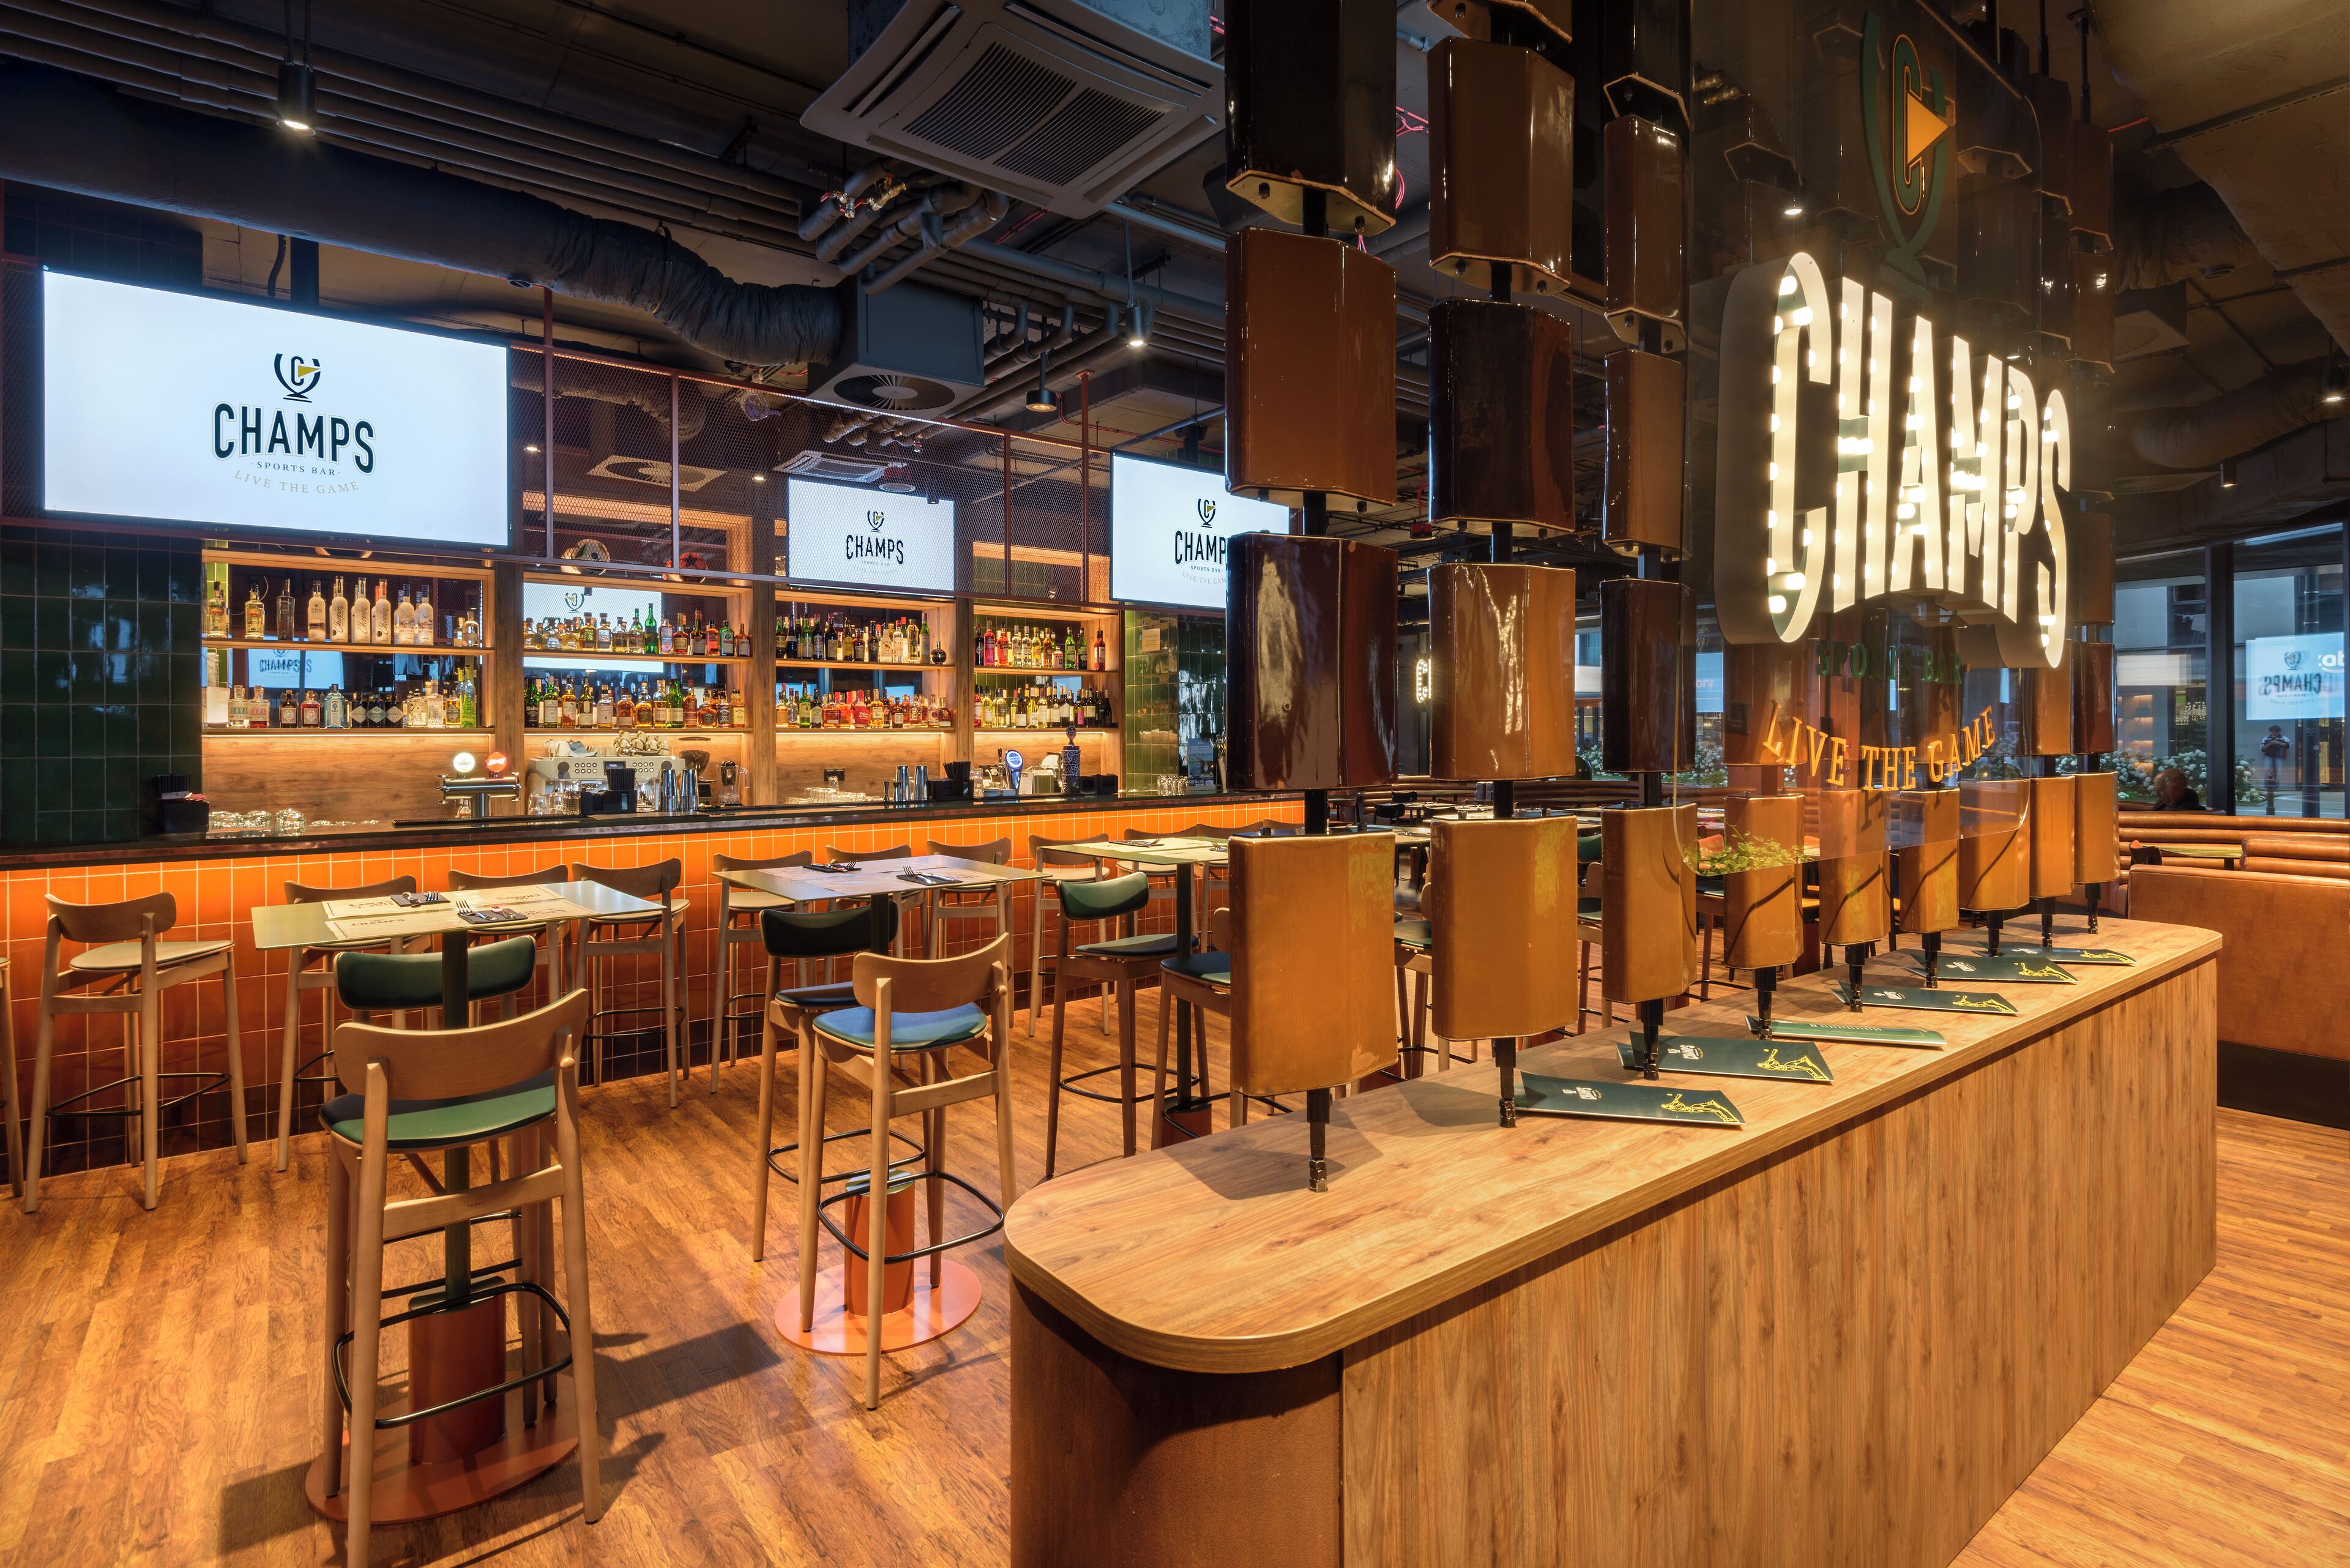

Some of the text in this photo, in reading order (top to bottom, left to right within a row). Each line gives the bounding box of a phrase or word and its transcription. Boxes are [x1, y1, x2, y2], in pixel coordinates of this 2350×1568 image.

[213, 401, 375, 475] CHAMPS
[256, 461, 336, 476] SPORTS BAR
[1766, 251, 2071, 670] CHAMPS
[234, 469, 359, 494] LIVE THE GAME
[846, 534, 904, 565] CHAMPS
[1174, 530, 1226, 565] CHAMP
[1182, 571, 1197, 582] LIVE
[334, 603, 344, 633] Chopin
[357, 606, 368, 634] Chopin
[378, 607, 389, 636] Chopin
[1921, 649, 1963, 685] BAR
[1762, 699, 1995, 791] LIVE THE GAME
